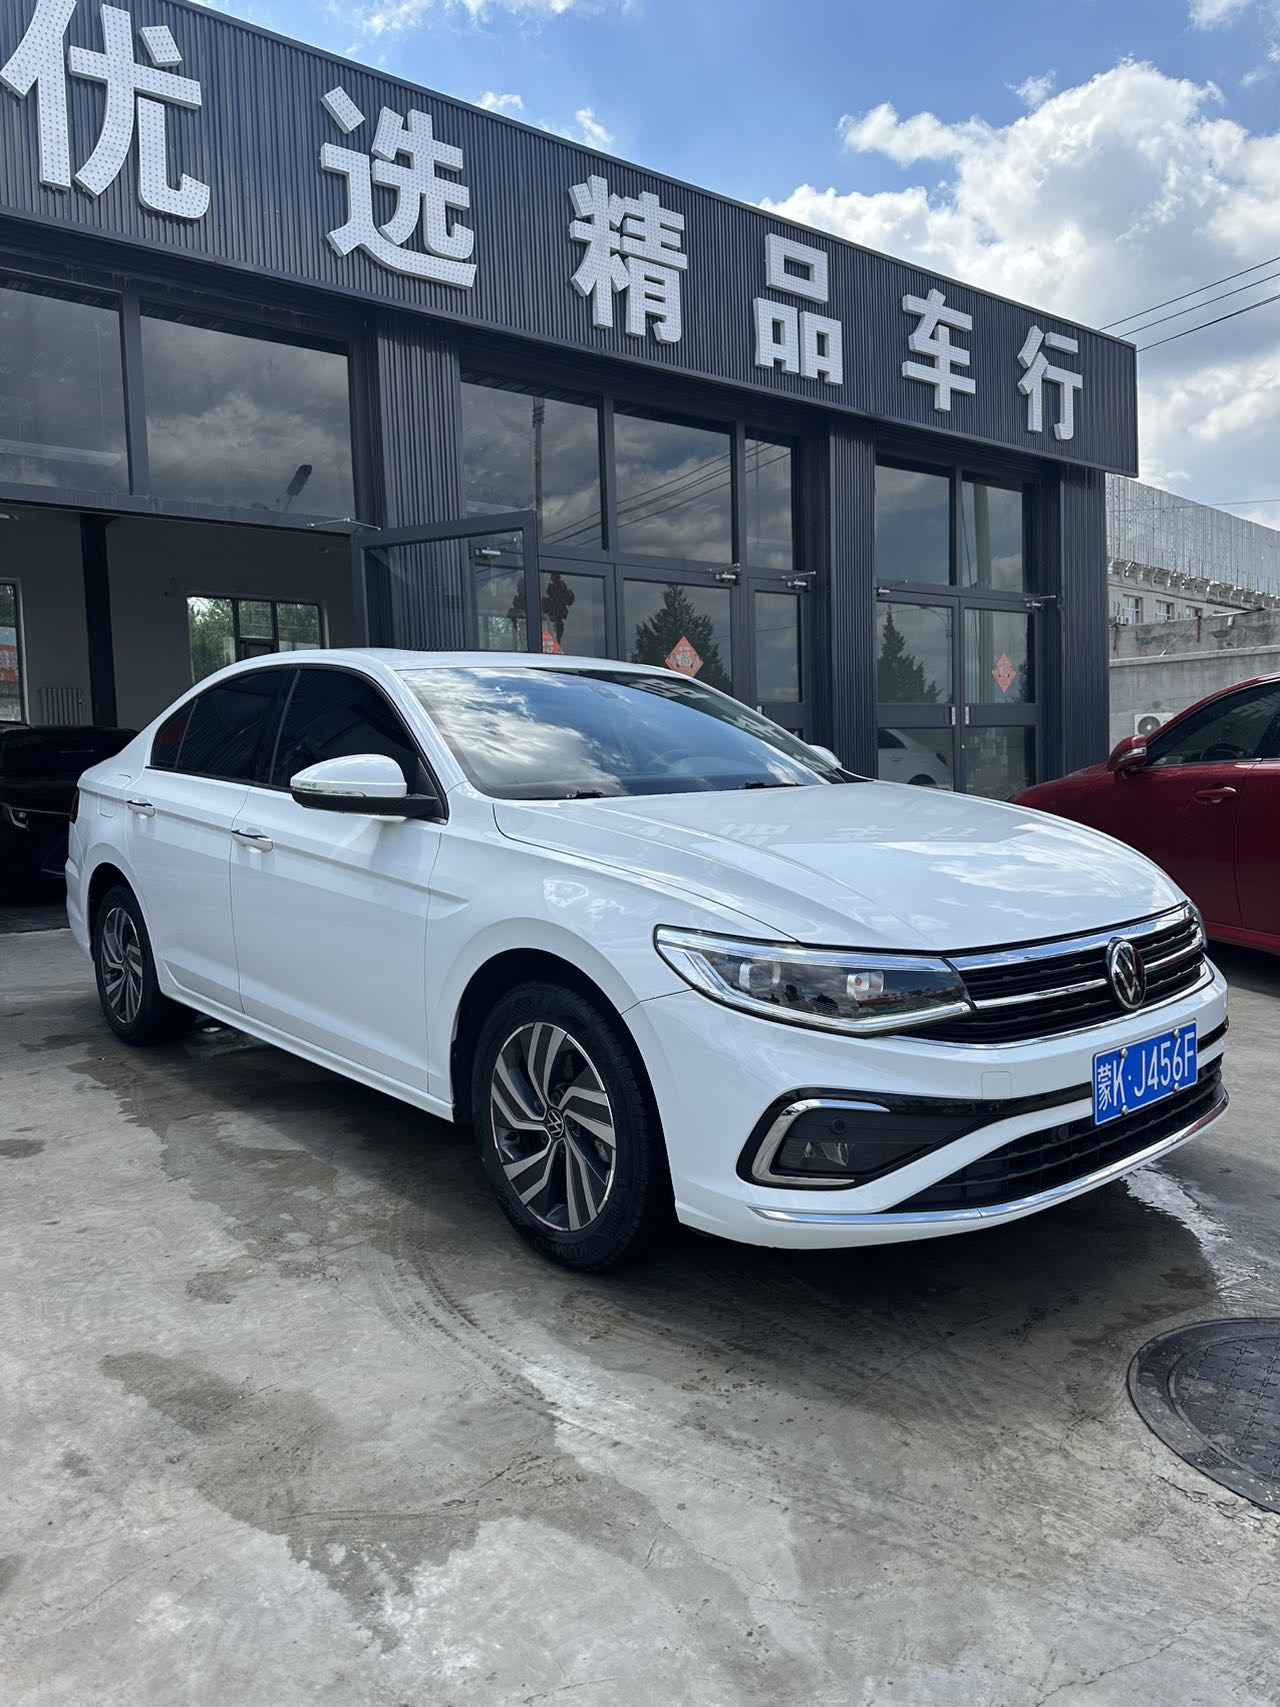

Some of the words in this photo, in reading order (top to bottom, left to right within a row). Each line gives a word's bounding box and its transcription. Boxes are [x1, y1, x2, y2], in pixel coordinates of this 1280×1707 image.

[0, 0, 1083, 441] 优选精品车行
